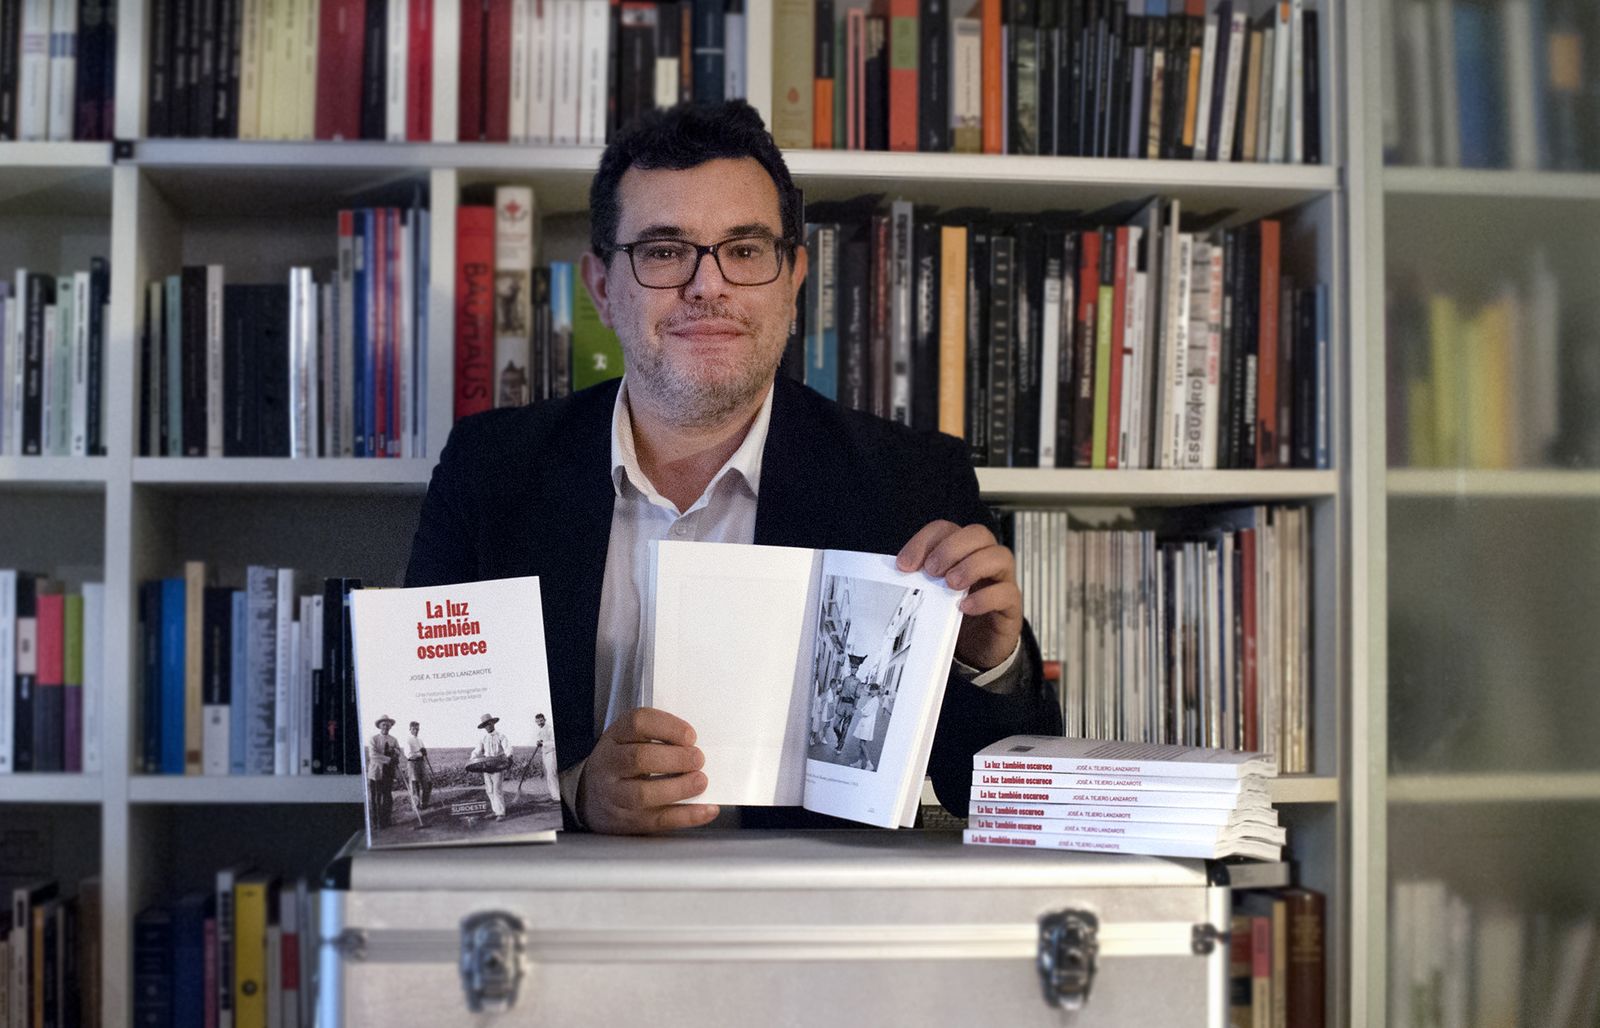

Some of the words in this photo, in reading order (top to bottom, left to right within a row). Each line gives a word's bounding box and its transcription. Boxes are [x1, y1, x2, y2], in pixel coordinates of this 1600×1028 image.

[463, 263, 488, 400] BAUHAUS
[995, 320, 1007, 367] AYER
[993, 380, 1006, 454] ESPAÑA
[426, 601, 443, 619] La
[446, 599, 469, 617] luz
[417, 618, 480, 640] también
[417, 640, 487, 660] oscurece
[409, 673, 424, 681] JOSÉ
[456, 668, 492, 677] LANZAROTE
[984, 760, 991, 768] La
[992, 761, 1001, 769] luz
[1002, 761, 1025, 769] también
[983, 775, 989, 783] La
[1001, 776, 1025, 784] también
[980, 790, 987, 798] La
[988, 790, 996, 798] luz
[998, 791, 1021, 799] también
[451, 803, 486, 812] SUROESTE
[977, 805, 984, 813] La
[985, 805, 993, 814] luz
[995, 806, 1018, 815] también
[978, 820, 984, 828] La
[985, 820, 993, 828] luz
[1018, 823, 1042, 831] oscurece
